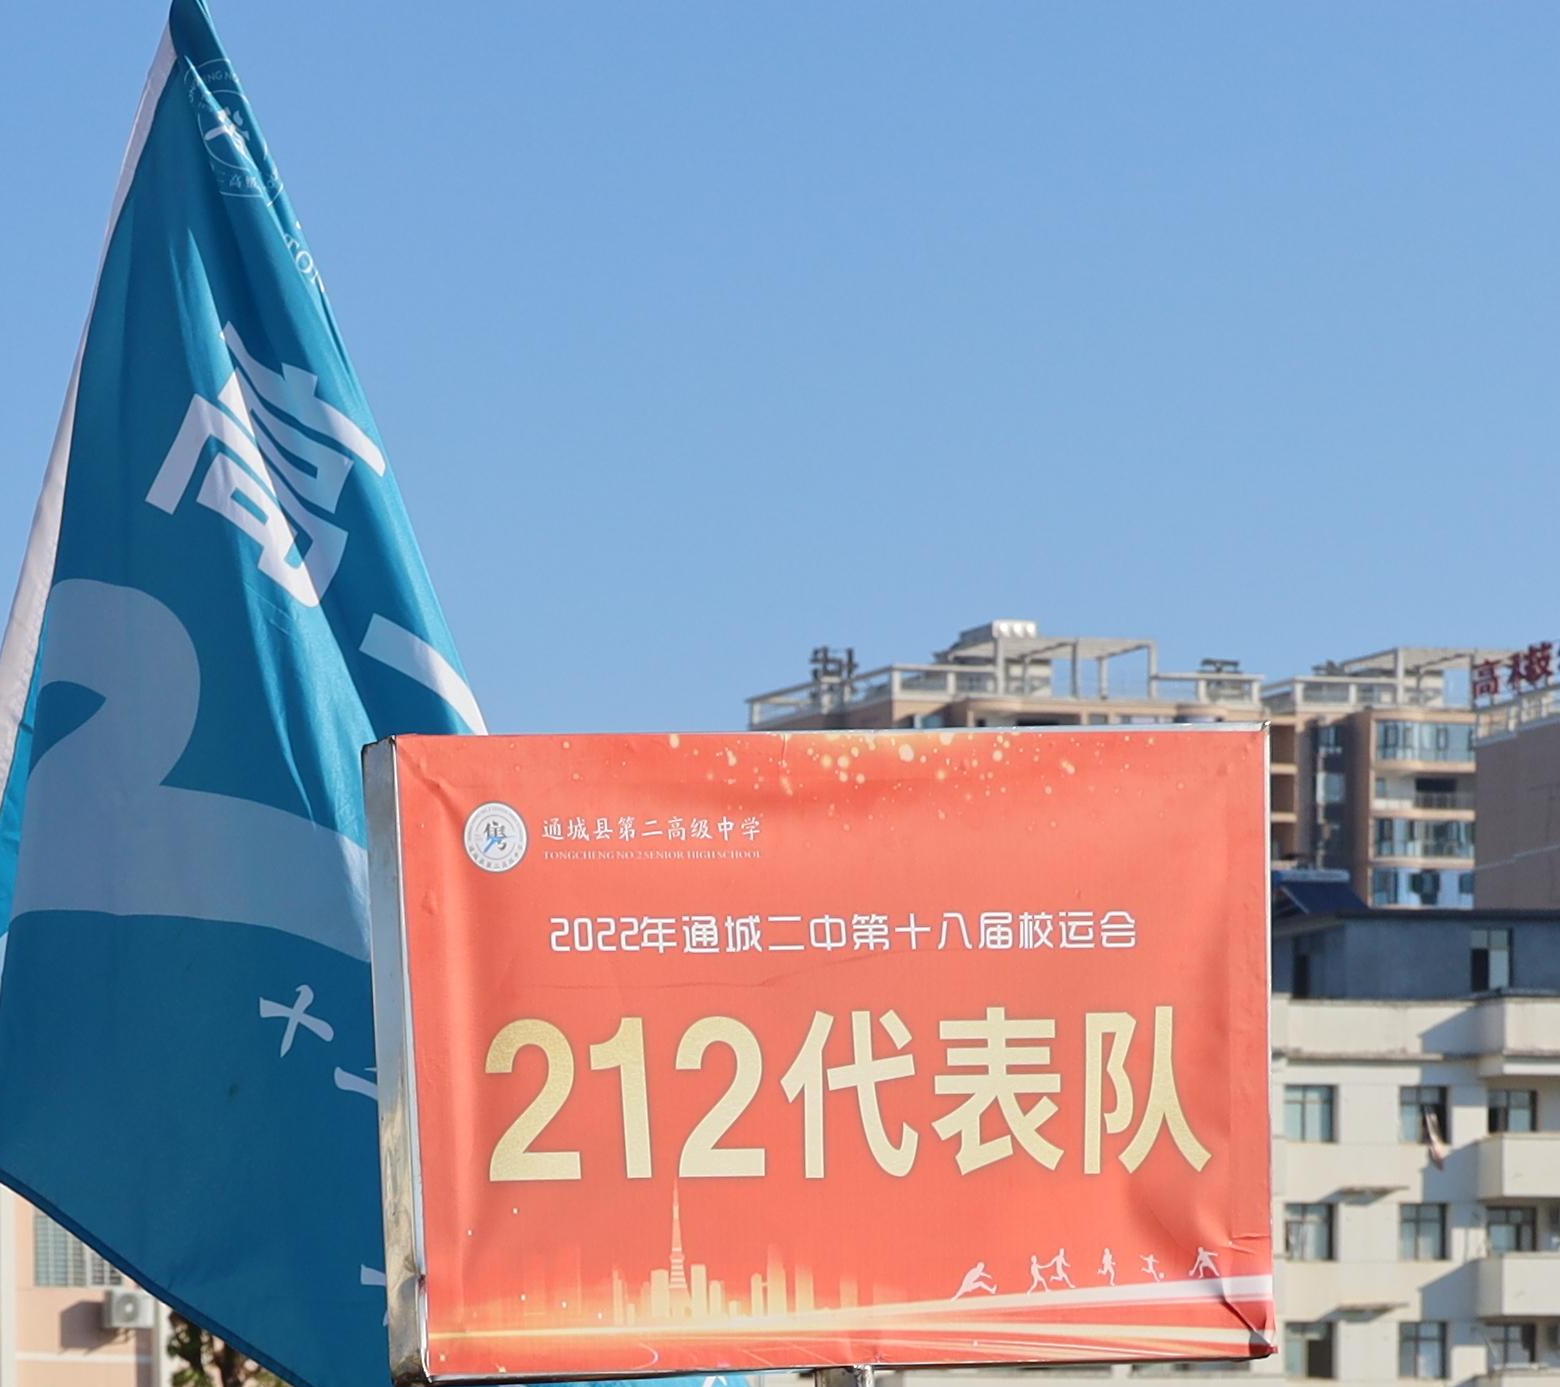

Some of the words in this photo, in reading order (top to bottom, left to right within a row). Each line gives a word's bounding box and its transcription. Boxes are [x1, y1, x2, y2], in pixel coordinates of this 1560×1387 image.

[542, 815, 761, 842] 通城县第二高级中学
[549, 910, 1138, 954] 2022年通城二中第十八届校运会
[484, 1005, 1213, 1183] 212代表队
